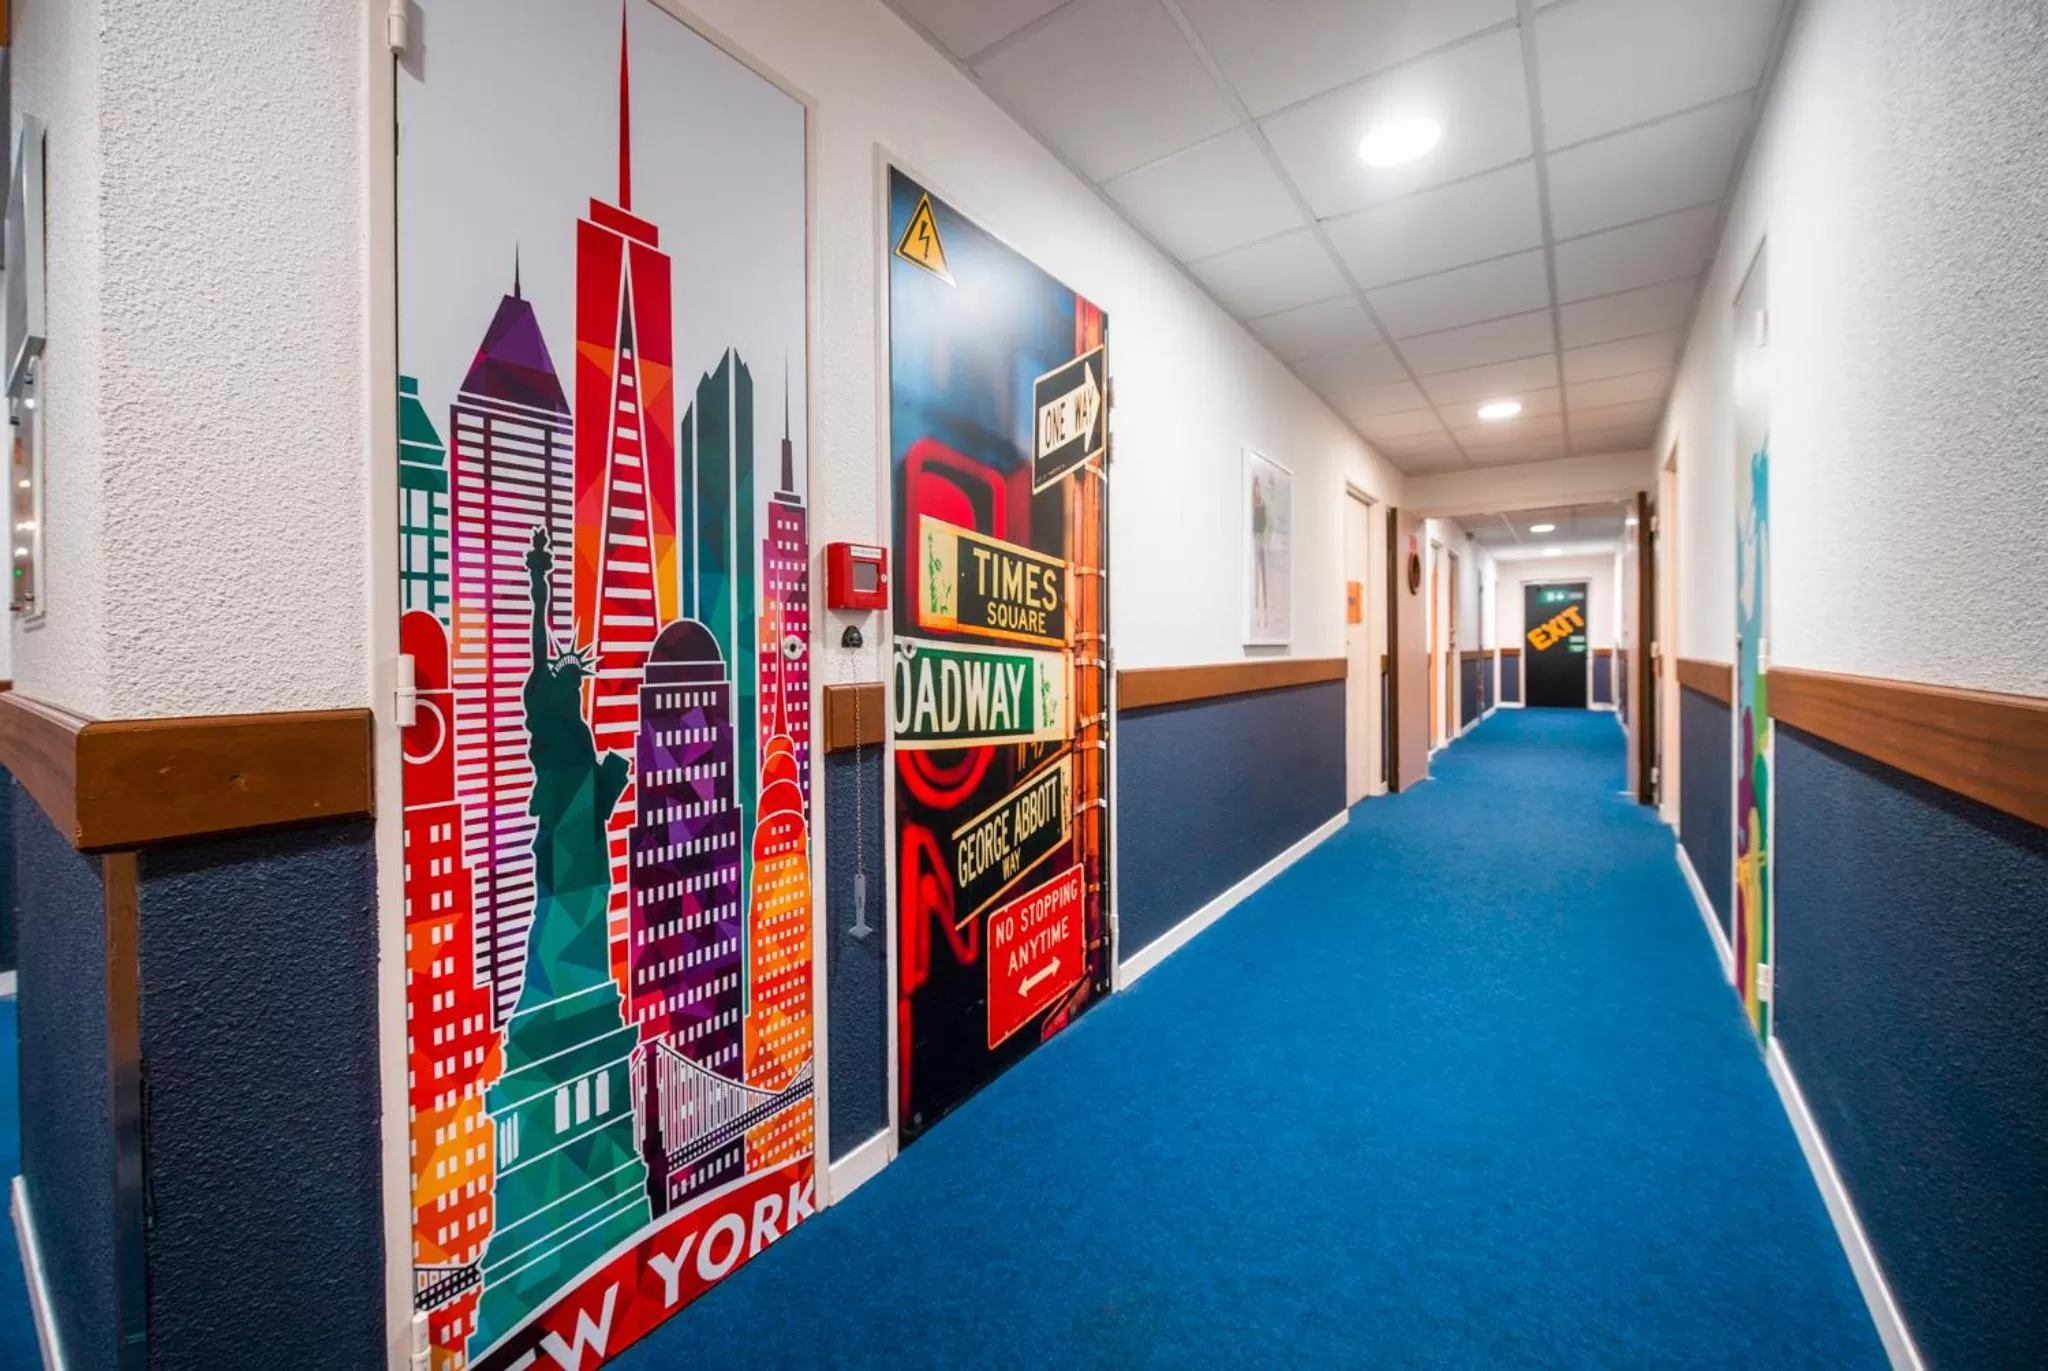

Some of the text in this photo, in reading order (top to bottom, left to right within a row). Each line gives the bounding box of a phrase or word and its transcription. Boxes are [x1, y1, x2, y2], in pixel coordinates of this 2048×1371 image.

[1045, 387, 1096, 449] ONE WAY
[972, 547, 1059, 612] TIMES
[986, 601, 1048, 634] SQUARE
[1527, 604, 1585, 652] EXIT
[958, 776, 1059, 889] GEORGE ABBOTT
[1002, 847, 1022, 882] WAY
[995, 878, 1079, 949] NO STOPPING
[1007, 916, 1070, 977] ANYTIME
[648, 1174, 815, 1310] YORK
